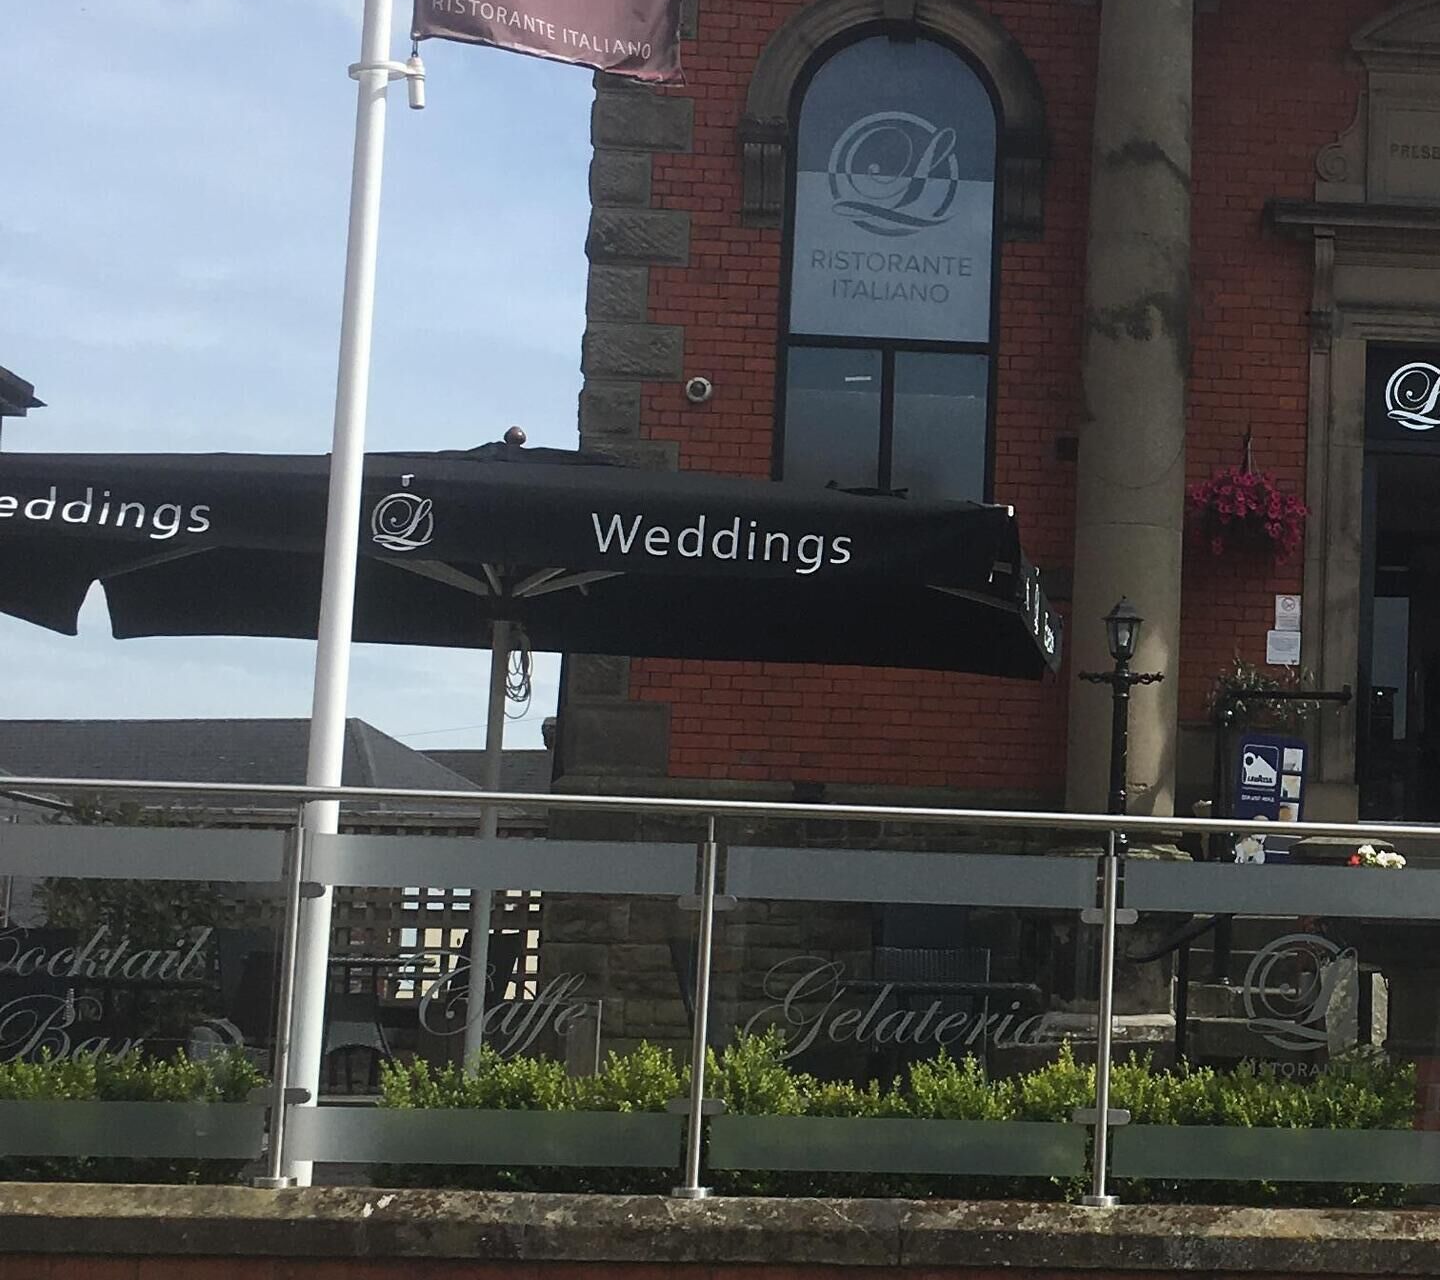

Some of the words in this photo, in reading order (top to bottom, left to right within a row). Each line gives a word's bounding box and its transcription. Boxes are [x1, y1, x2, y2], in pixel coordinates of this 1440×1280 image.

[563, 28, 651, 60] ITALIANO
[810, 249, 973, 277] RISTORANTE
[831, 278, 950, 304] ITALIANO
[591, 512, 852, 575] Weddings
[744, 956, 1055, 1061] Gelateria
